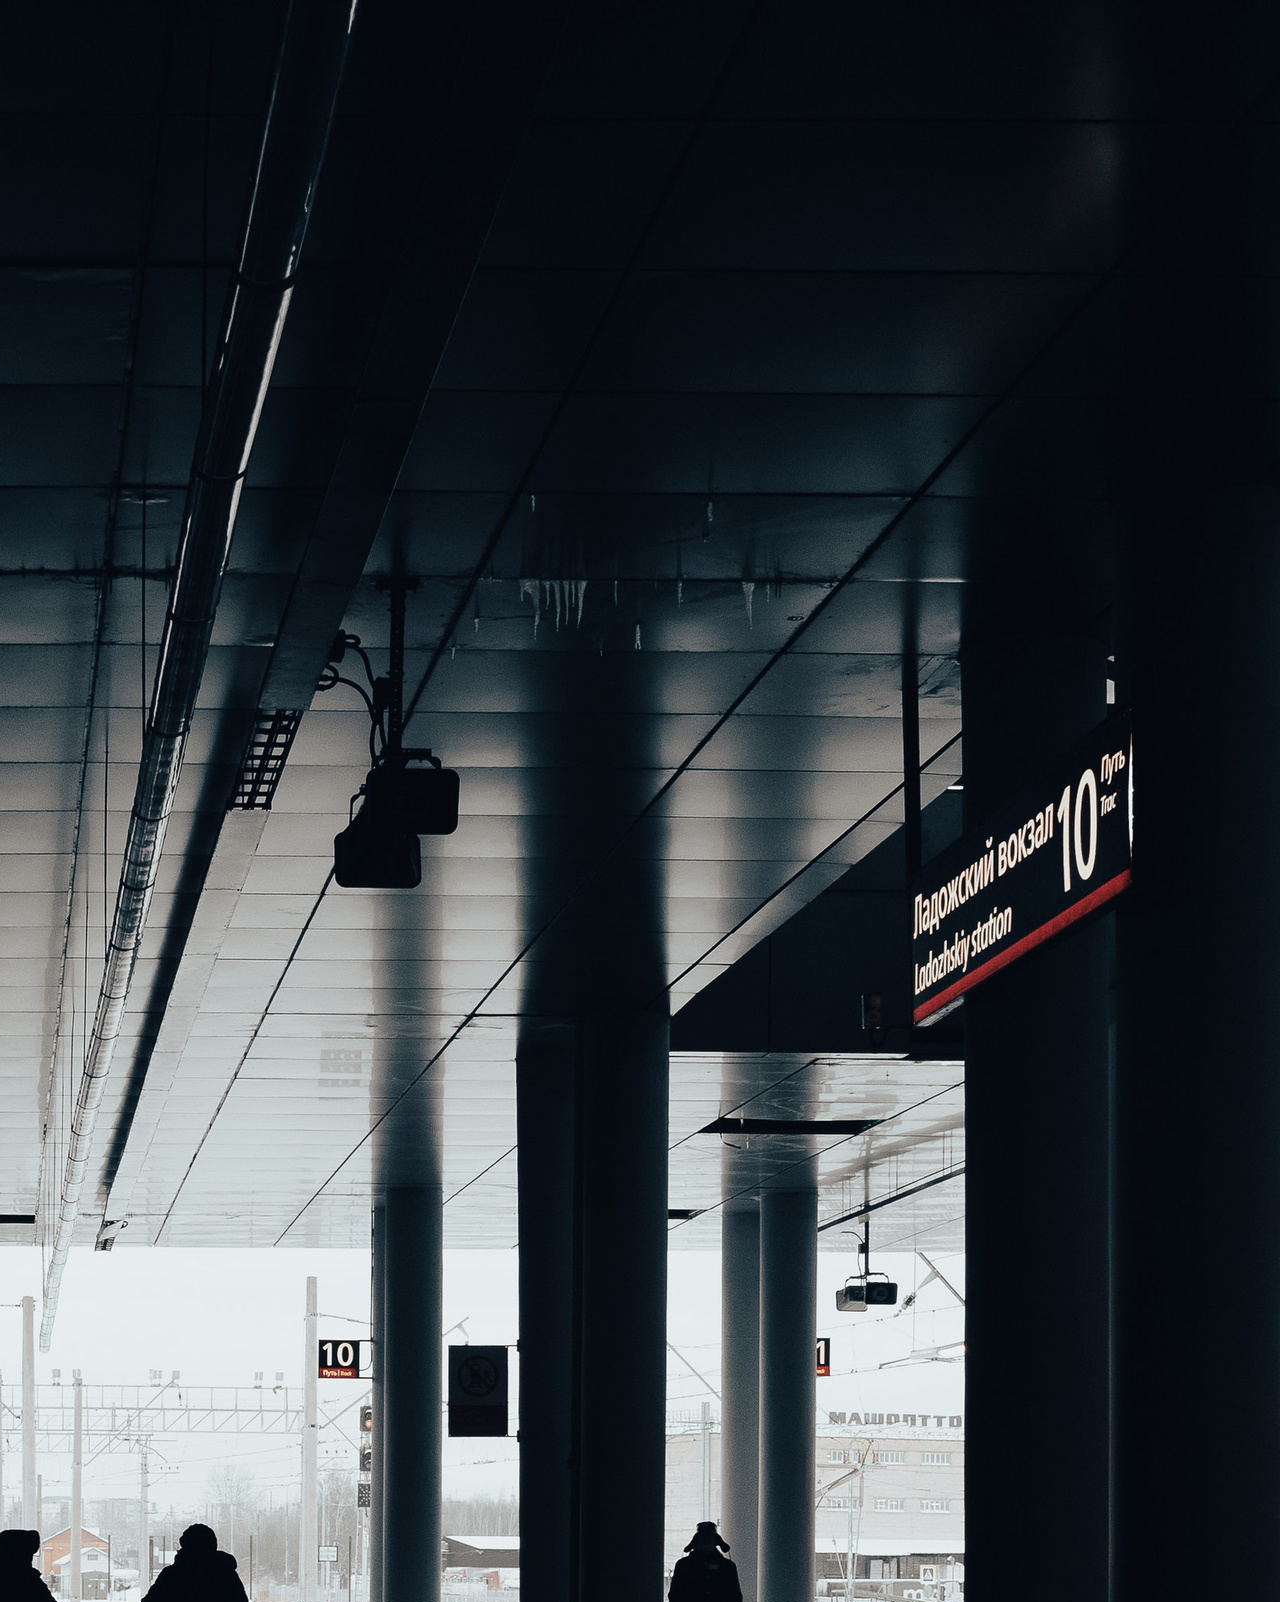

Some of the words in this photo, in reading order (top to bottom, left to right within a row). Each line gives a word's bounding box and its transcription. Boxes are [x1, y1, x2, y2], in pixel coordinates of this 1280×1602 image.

[1100, 749, 1127, 786] Путь
[913, 836, 995, 940] Ладожский
[997, 802, 1055, 878] вокзал
[1056, 768, 1098, 893] 10
[914, 930, 971, 996] Ladozhskiy
[970, 906, 1013, 958] station
[322, 1342, 354, 1367] 10
